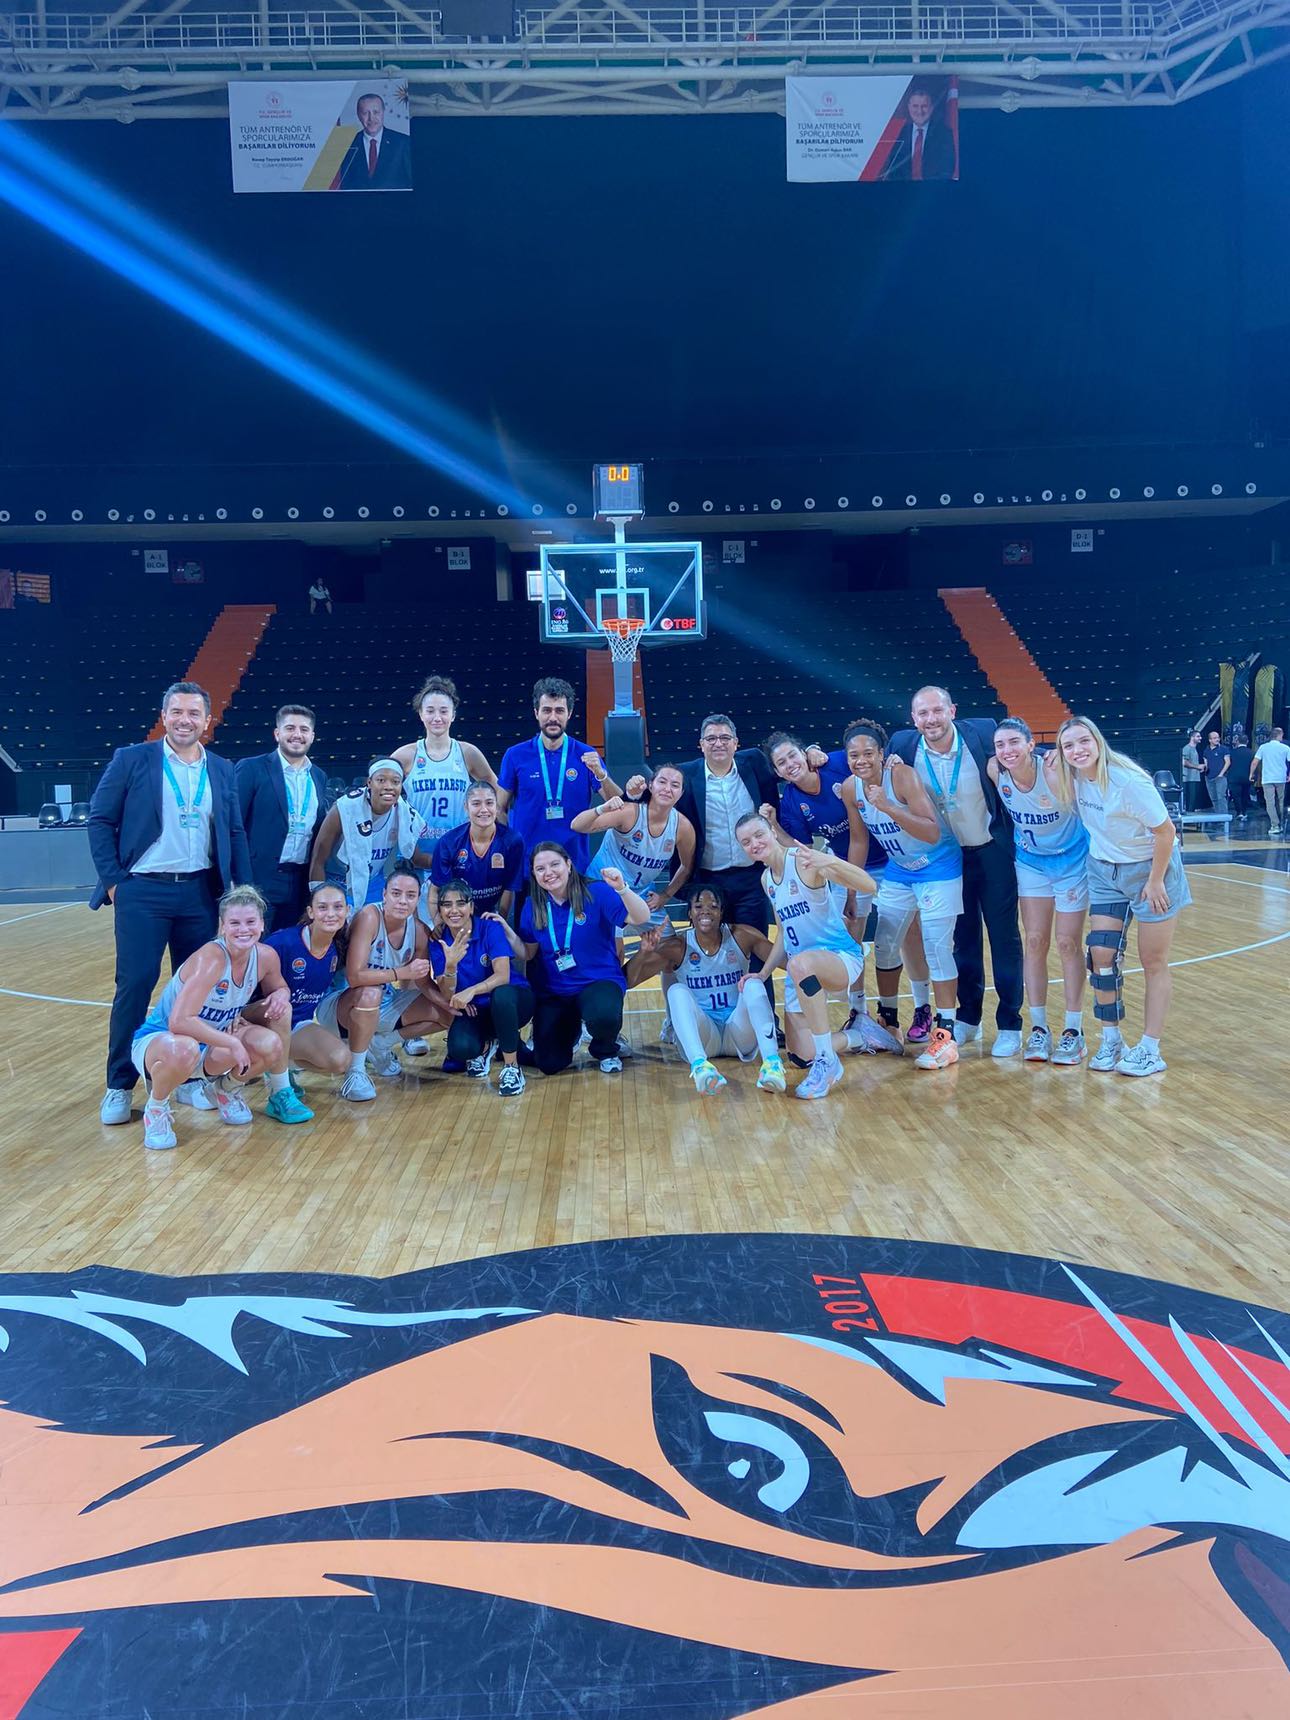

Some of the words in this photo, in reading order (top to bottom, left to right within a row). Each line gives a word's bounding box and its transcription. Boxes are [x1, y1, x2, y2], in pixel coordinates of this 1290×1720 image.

[240, 125, 257, 133] TÜM
[258, 124, 302, 133] ANTRENÖR
[815, 122, 852, 130] ANTRENÖR
[608, 465, 630, 482] 0.0
[673, 618, 696, 630] TBF
[438, 778, 467, 793] TARSUS
[431, 796, 448, 818] 12
[1023, 811, 1060, 825] TARSUS
[1023, 829, 1037, 847] 7
[881, 839, 905, 856] 44
[634, 871, 642, 887] 1
[786, 925, 799, 947] 9
[709, 992, 728, 1010] 14
[812, 1274, 879, 1331] 2017
